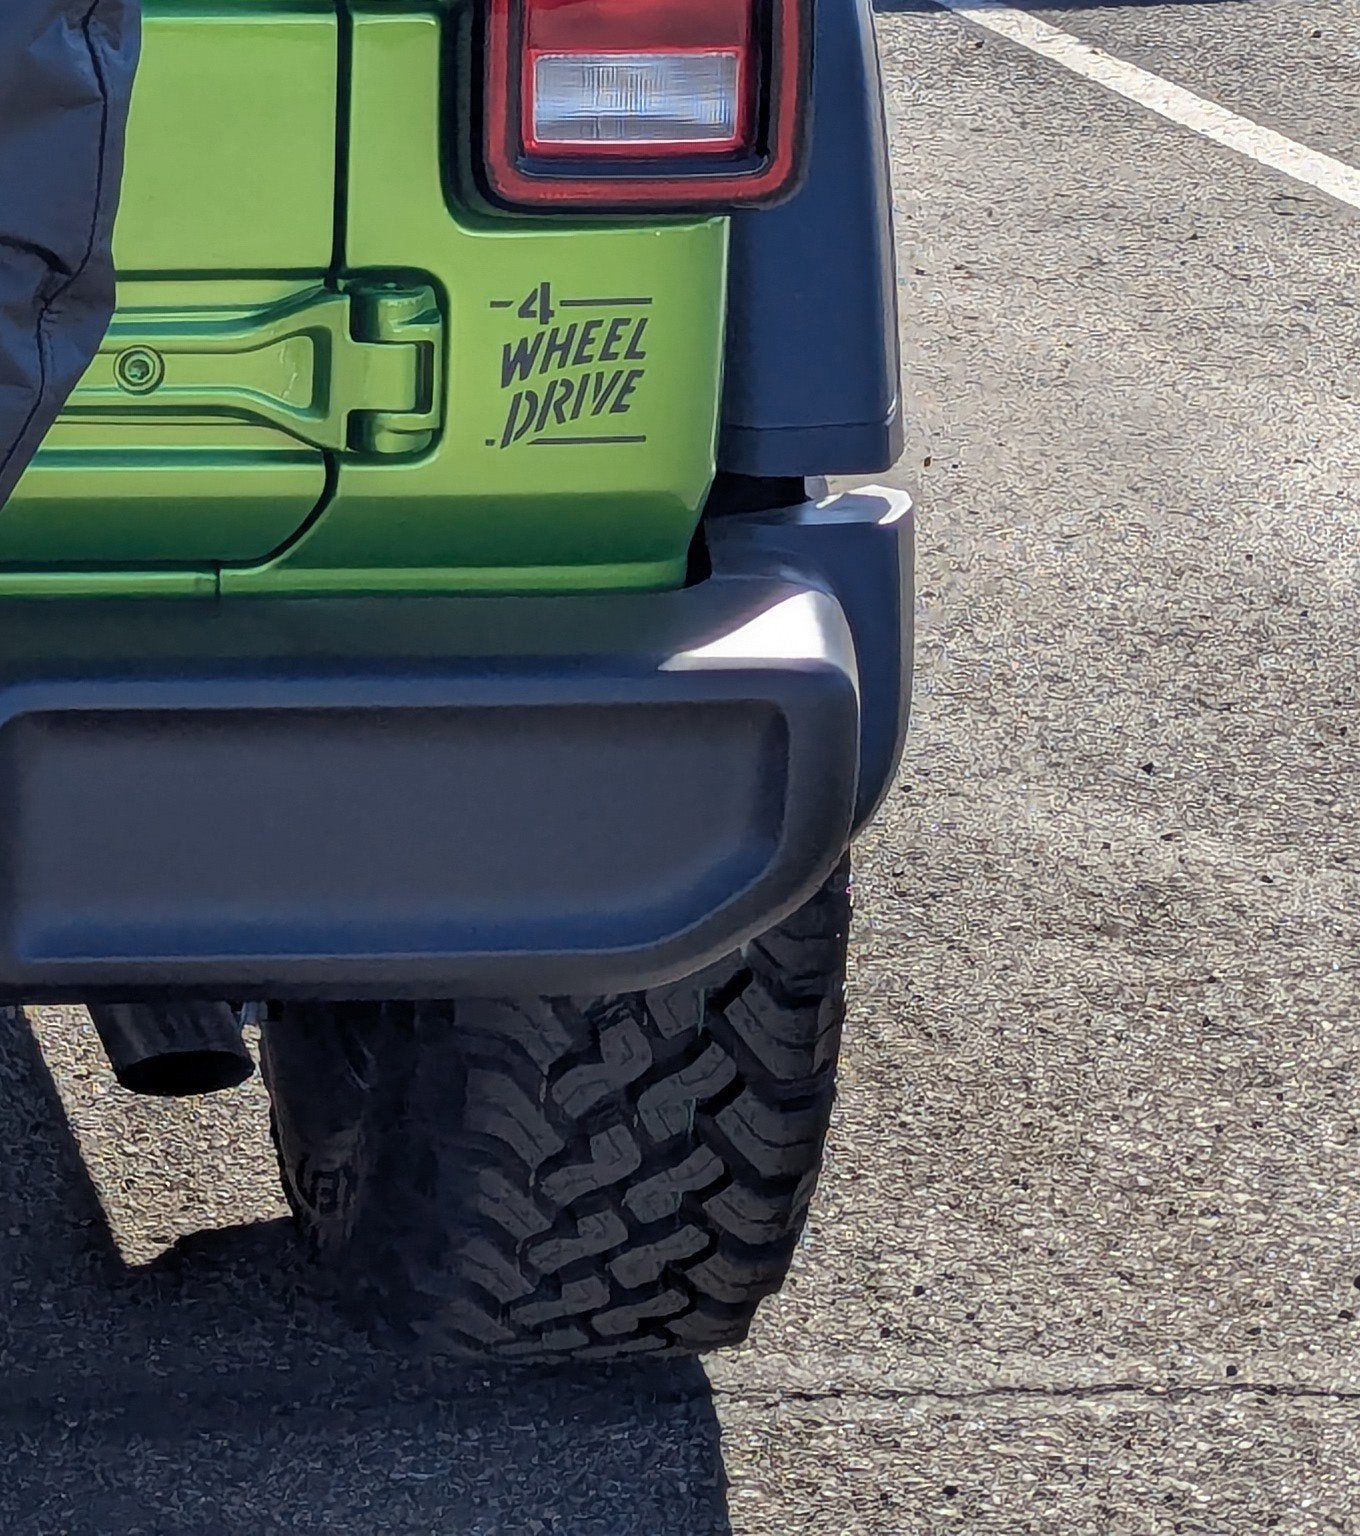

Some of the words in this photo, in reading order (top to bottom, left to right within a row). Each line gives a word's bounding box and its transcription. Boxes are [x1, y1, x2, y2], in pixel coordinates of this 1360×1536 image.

[518, 282, 555, 325] 4
[500, 317, 649, 388] WHEEL
[499, 369, 645, 449] DRIVE
